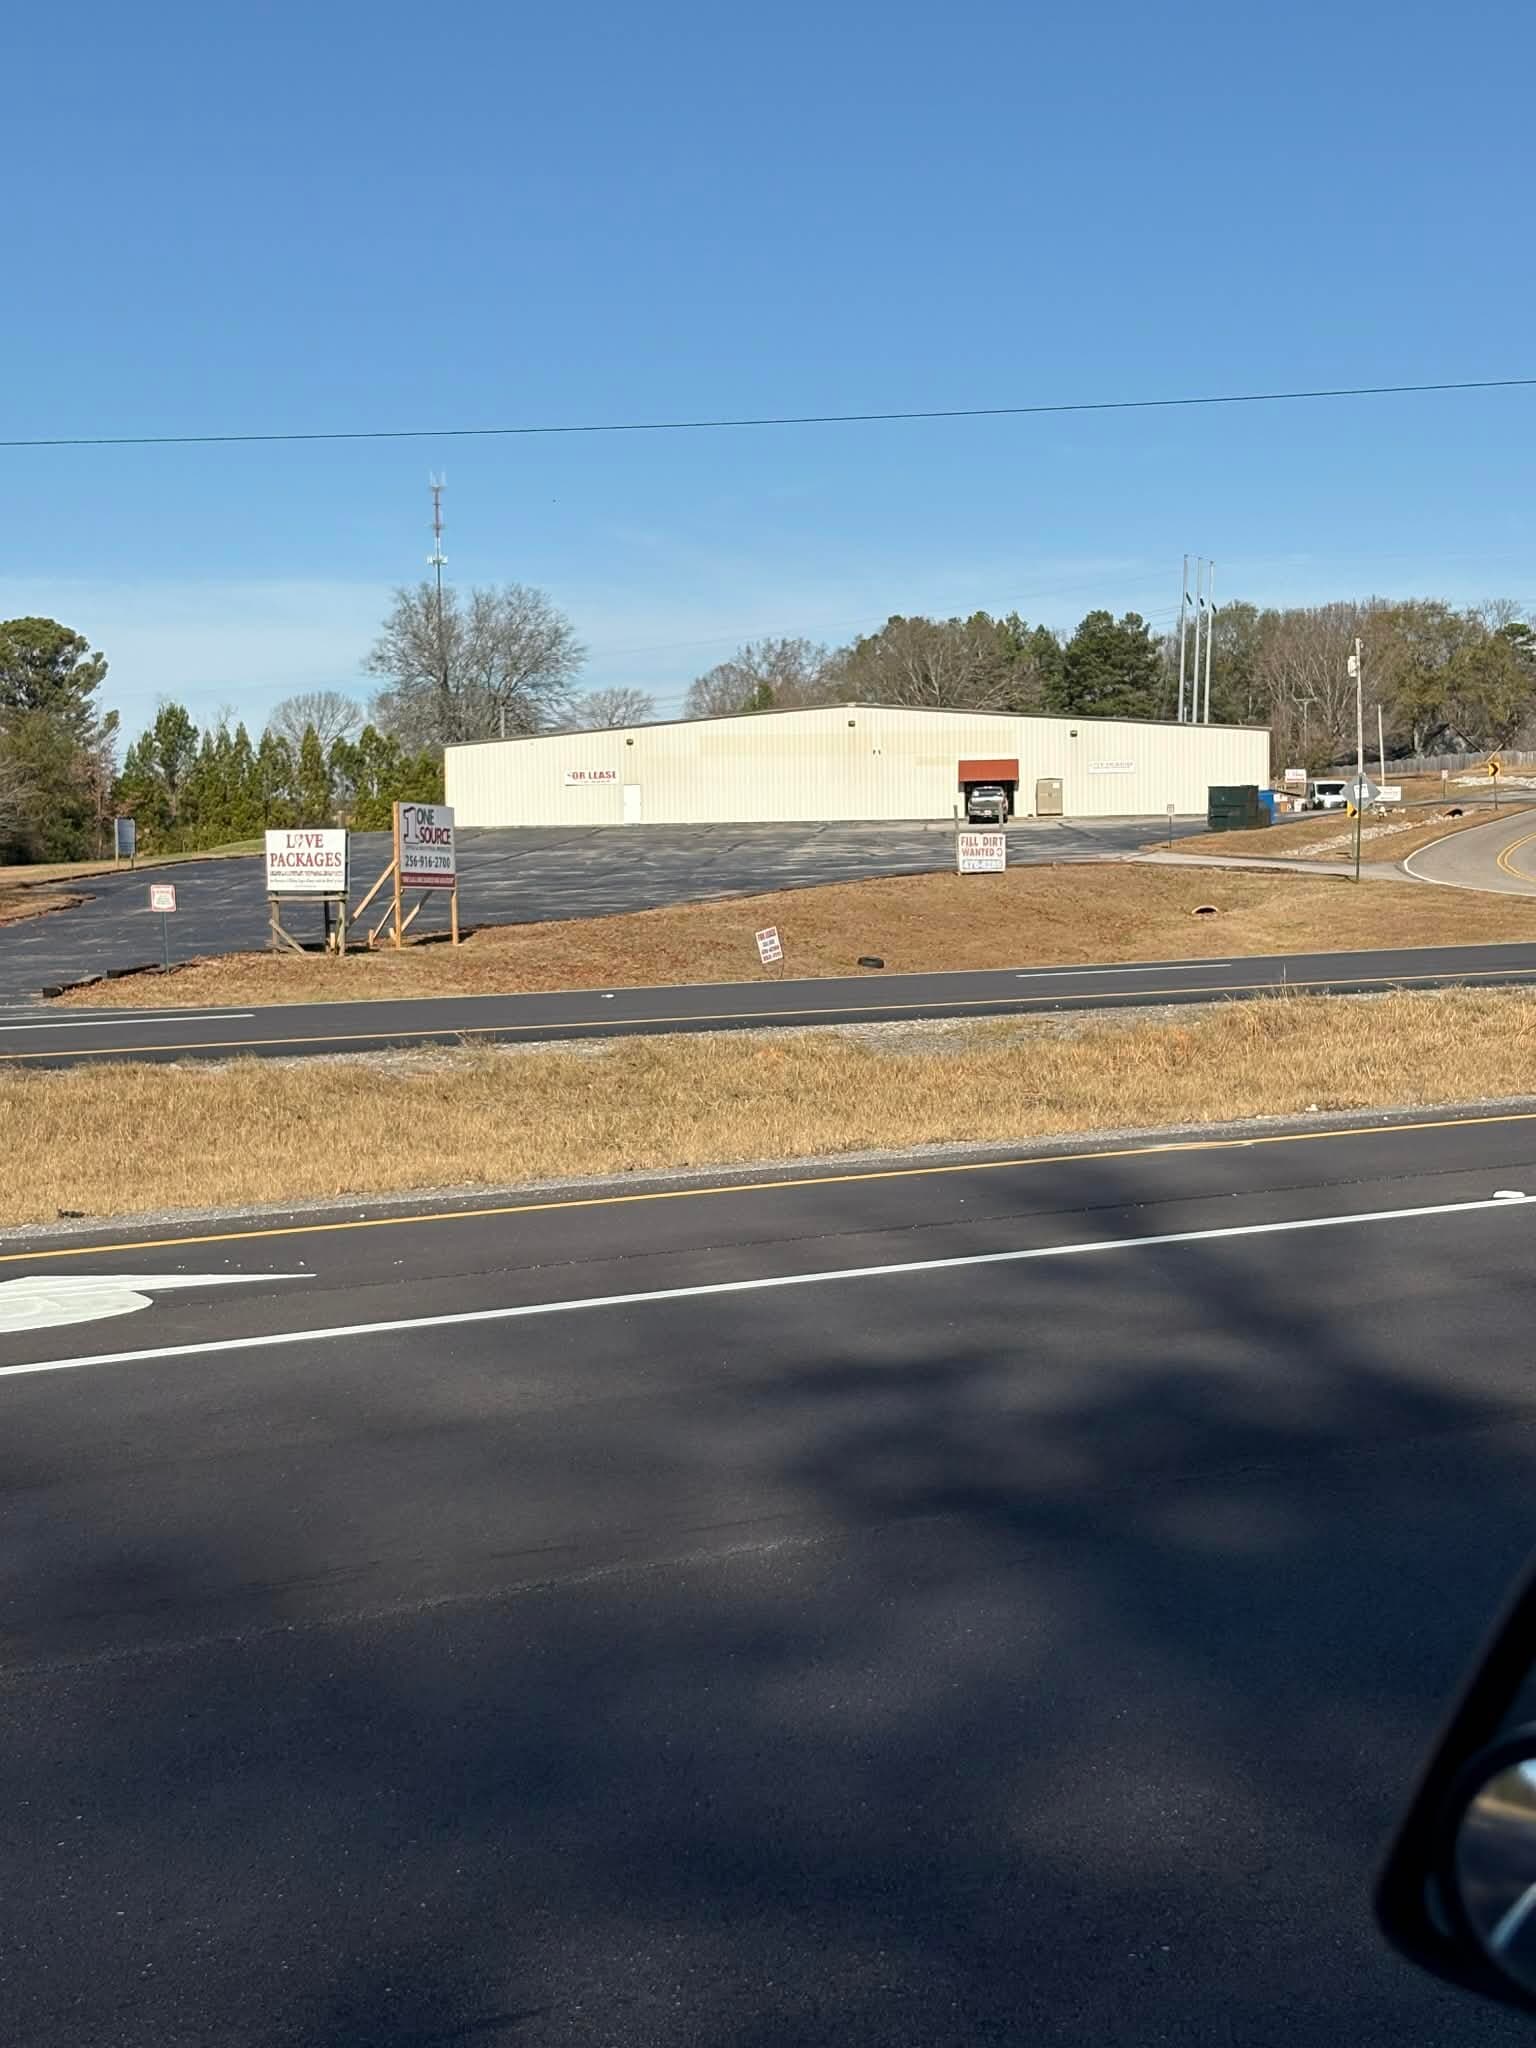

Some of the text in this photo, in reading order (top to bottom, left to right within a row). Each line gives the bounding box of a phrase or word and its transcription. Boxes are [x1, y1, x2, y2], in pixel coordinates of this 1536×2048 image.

[567, 771, 585, 779] OR
[417, 808, 434, 825] ONE
[420, 826, 451, 845] SOURCE
[960, 836, 1003, 846] FILL DIRT
[961, 848, 995, 856] WANTED
[270, 852, 342, 867] PACKAGES
